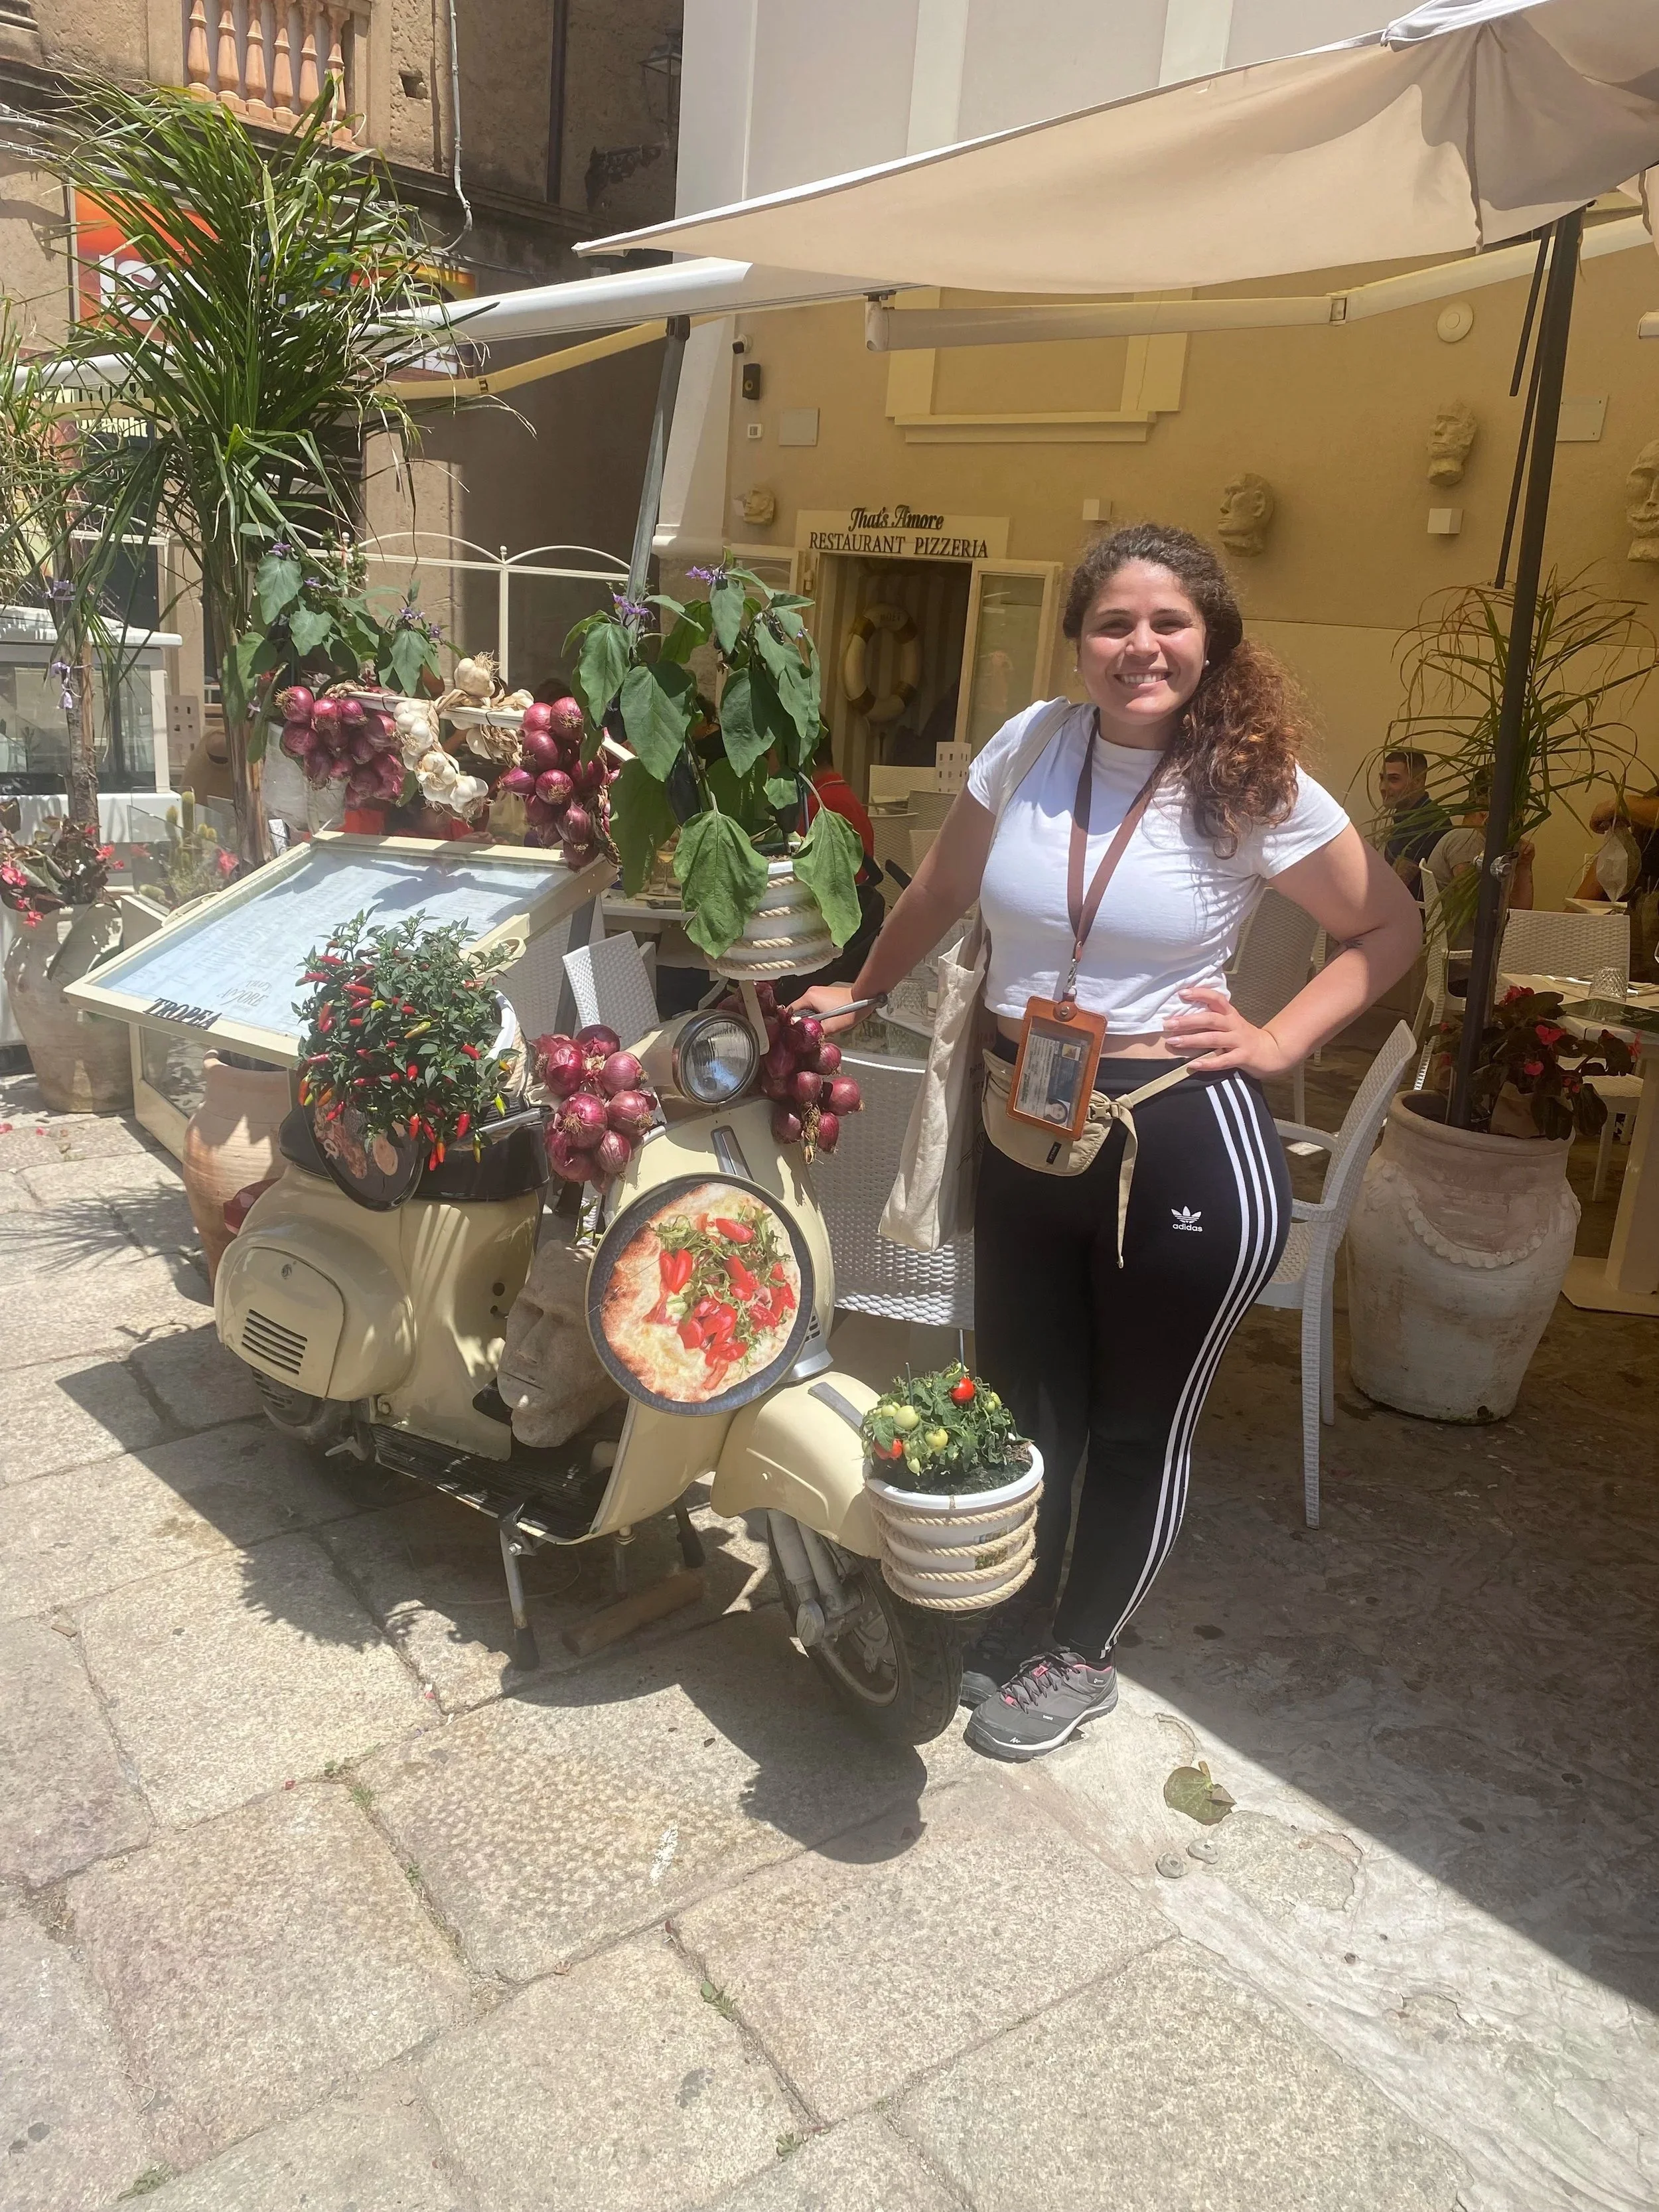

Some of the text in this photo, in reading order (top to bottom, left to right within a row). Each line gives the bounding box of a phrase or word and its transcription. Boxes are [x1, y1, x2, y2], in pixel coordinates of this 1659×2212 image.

[848, 506, 889, 532] That's
[808, 532, 989, 558] RESTAURANT PIZZERIA
[142, 997, 223, 1031] TROPEA
[1172, 1223, 1203, 1232] adidas
